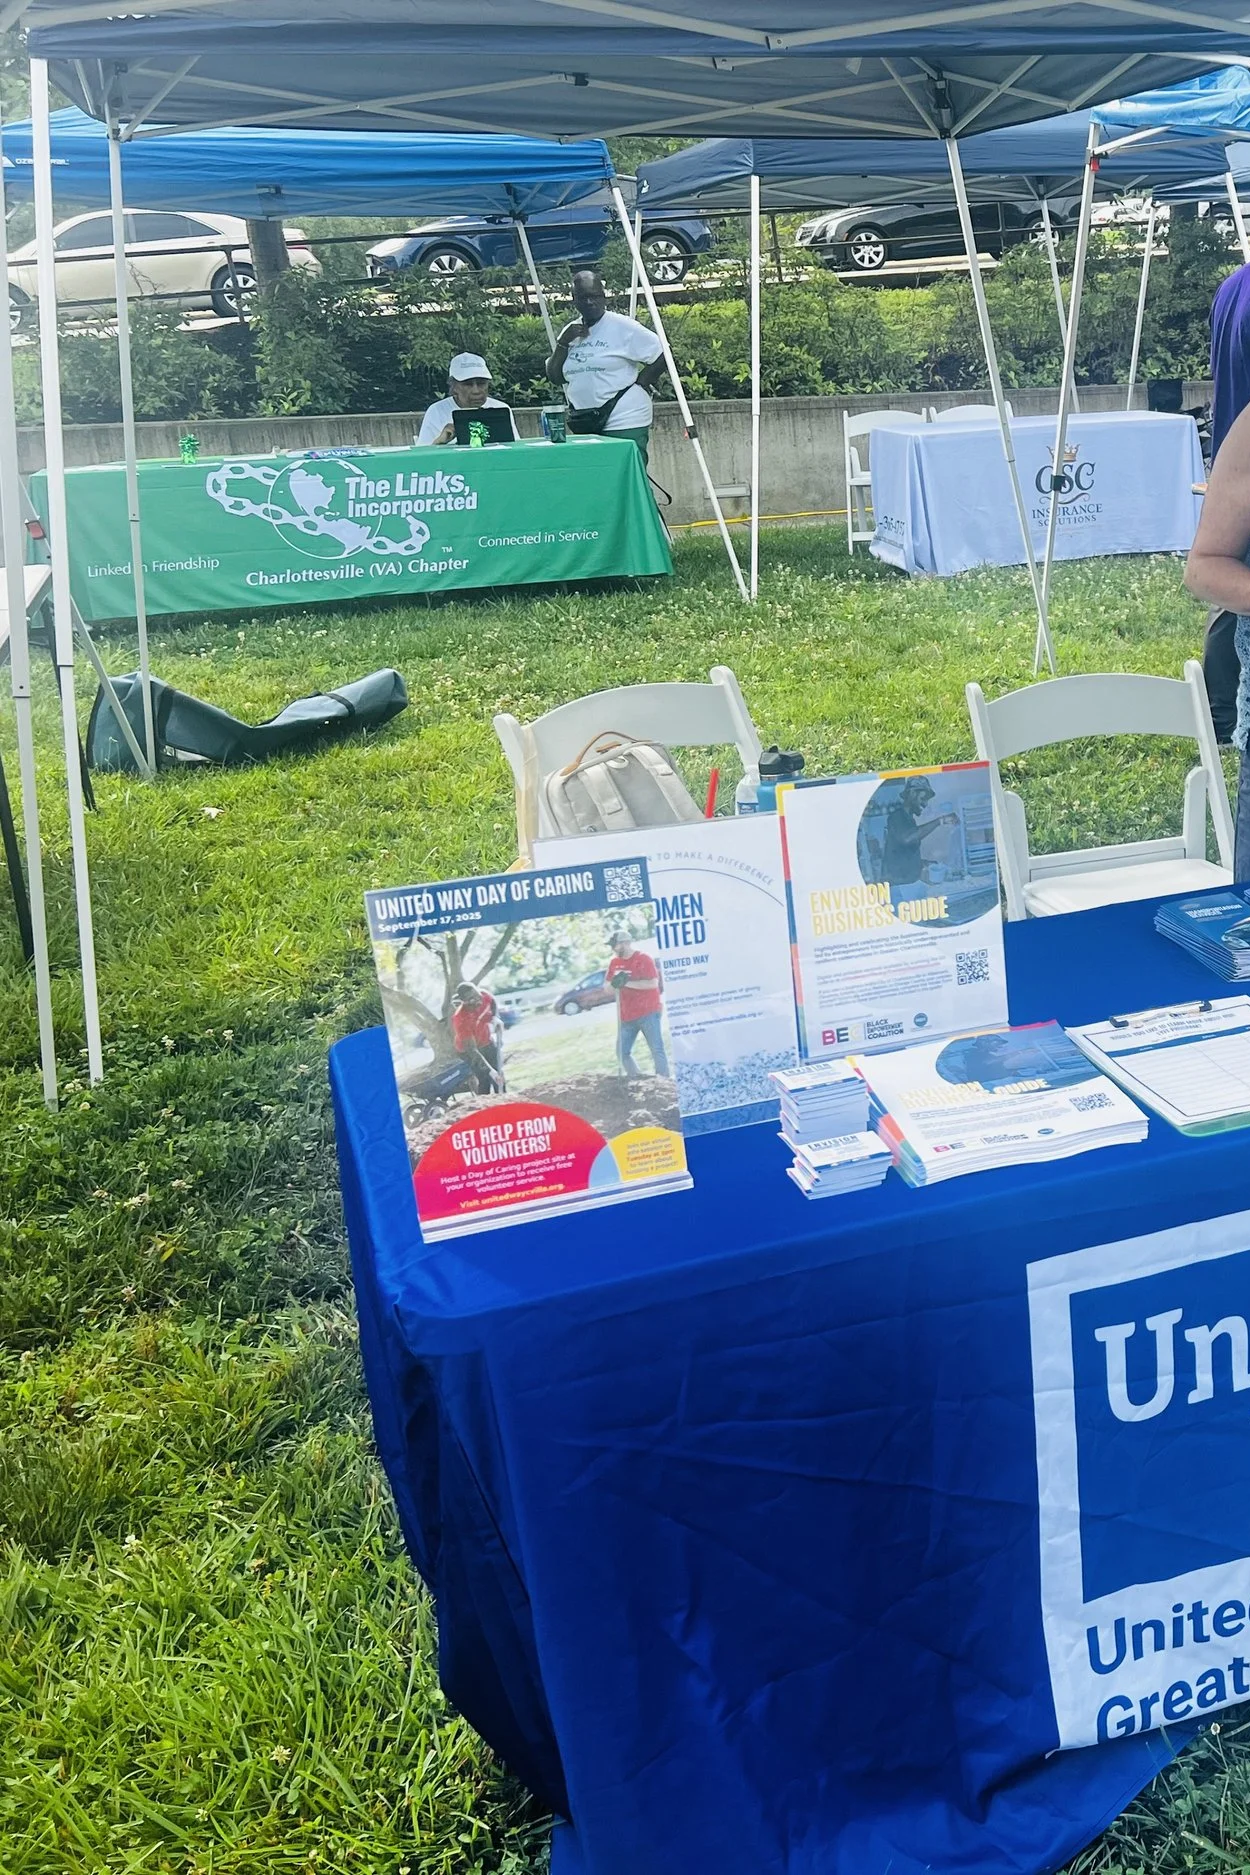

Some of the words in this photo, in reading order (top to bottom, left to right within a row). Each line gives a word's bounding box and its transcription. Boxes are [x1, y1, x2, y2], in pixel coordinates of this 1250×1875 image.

[345, 475, 390, 500] The
[395, 470, 471, 498] Links,
[347, 492, 478, 518] Incorporated
[1038, 514, 1097, 528] SOUTIONS
[478, 530, 541, 549] Connected
[545, 532, 555, 543] in
[558, 529, 599, 542] Service
[88, 563, 131, 578] Linked
[152, 556, 220, 574] Friendship
[245, 563, 365, 587] Charlottesville
[369, 561, 402, 579] (VA)
[408, 557, 470, 577] Chapter
[656, 852, 671, 861] TO
[675, 851, 702, 860] MAKE
[707, 852, 713, 861] A
[717, 855, 775, 886] DIFFERENCE
[375, 893, 435, 920] UNITED
[436, 887, 473, 912] WAY
[476, 882, 507, 907] DAY
[510, 879, 531, 902] OF
[533, 871, 595, 898] CARING
[809, 882, 891, 914] ENVISION
[378, 918, 438, 933] September
[439, 914, 455, 924] 17,
[456, 911, 482, 922] 2025
[812, 903, 895, 936] BUSINESS
[897, 895, 950, 924] GUIDE
[663, 957, 691, 969] UNITED
[692, 954, 710, 965] WAY
[866, 1018, 889, 1027] BLACK
[867, 1022, 904, 1034] EMPOWERMENT
[867, 1028, 904, 1040] COALITION
[782, 1063, 832, 1077] ENVISION
[452, 1129, 476, 1150] GET
[480, 1123, 514, 1146] HELP
[516, 1115, 556, 1138] FROM
[808, 1135, 860, 1151] ENVISION
[462, 1134, 552, 1167] VOLUNTEERS!
[440, 1175, 460, 1185] Host
[468, 1169, 485, 1181] Day
[485, 1167, 494, 1175] of
[495, 1163, 521, 1174] Caring
[522, 1158, 551, 1171] project
[551, 1154, 567, 1163] site
[567, 1152, 576, 1160] at
[446, 1183, 465, 1194] your
[465, 1173, 516, 1189] organization
[516, 1170, 526, 1178] to
[527, 1165, 555, 1176] receive
[556, 1161, 573, 1170] free
[476, 1181, 514, 1194] volunteer
[460, 1198, 481, 1209] Visit
